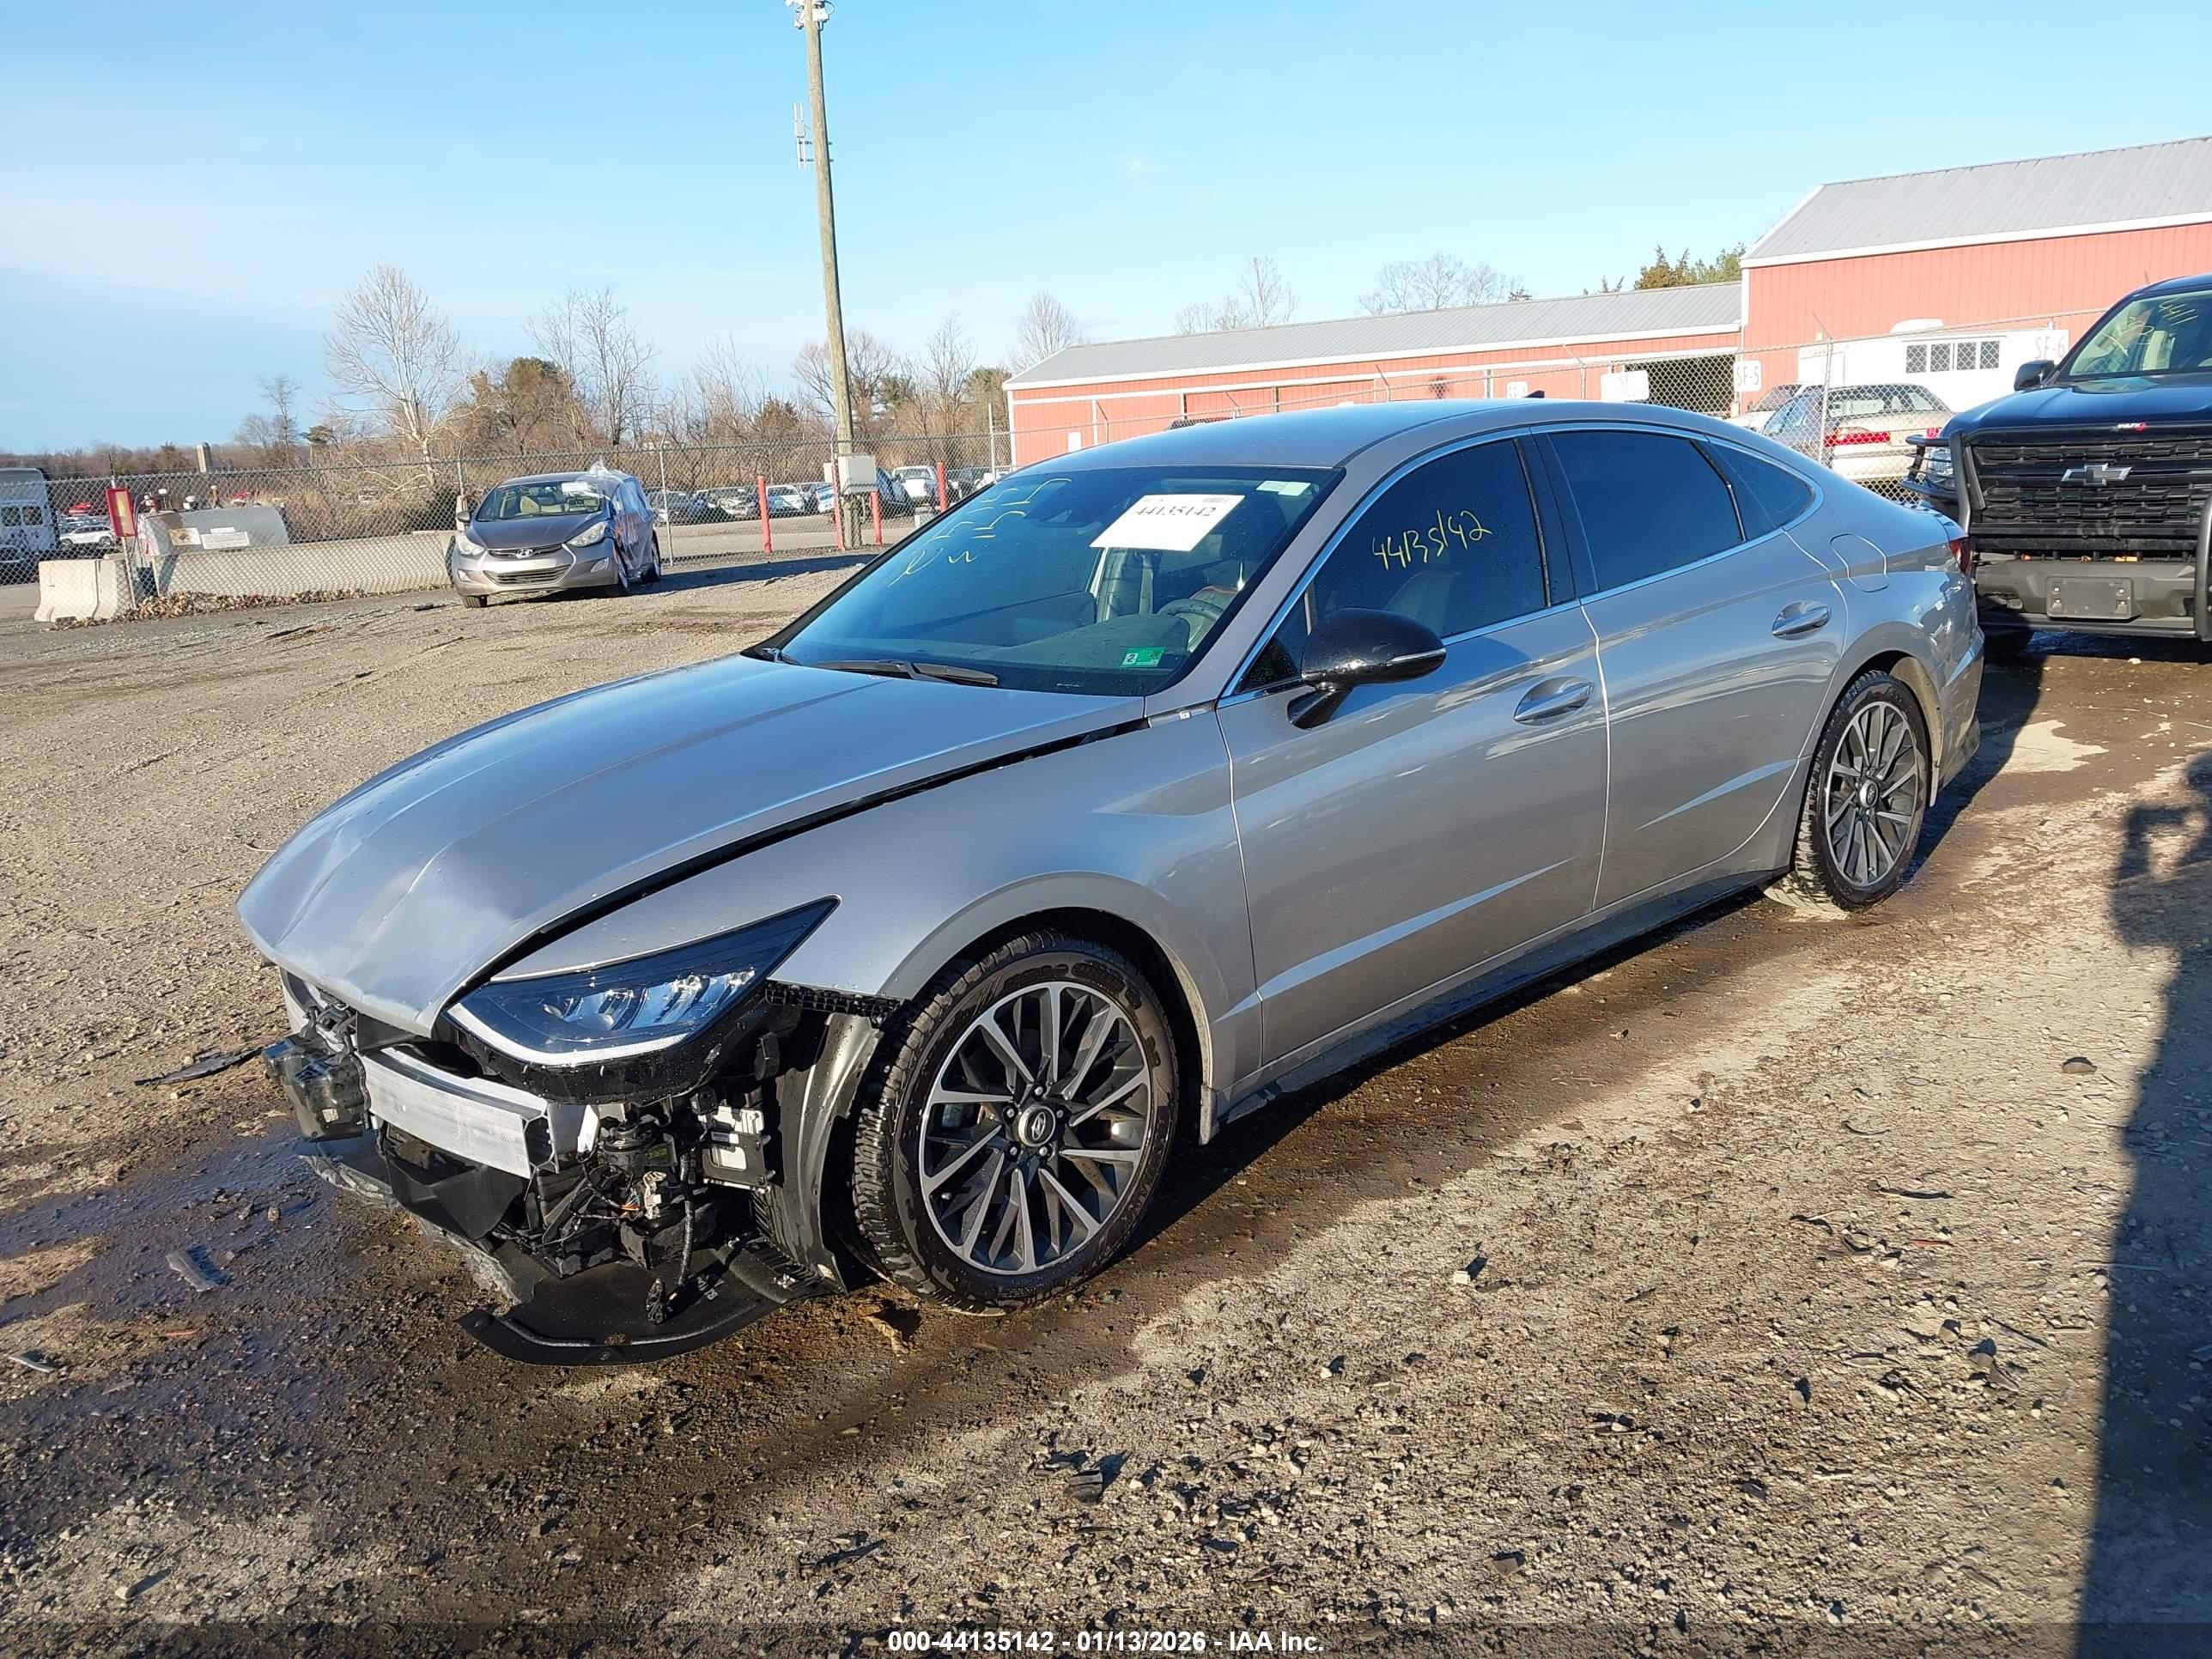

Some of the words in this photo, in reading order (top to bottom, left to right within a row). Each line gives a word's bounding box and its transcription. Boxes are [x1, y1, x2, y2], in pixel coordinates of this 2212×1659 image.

[2034, 336, 2066, 359] SF-6
[1736, 366, 1759, 386] SF-5
[1135, 506, 1217, 517] 44135142
[1371, 509, 1493, 570] 44135142
[1127, 653, 1136, 663] 2
